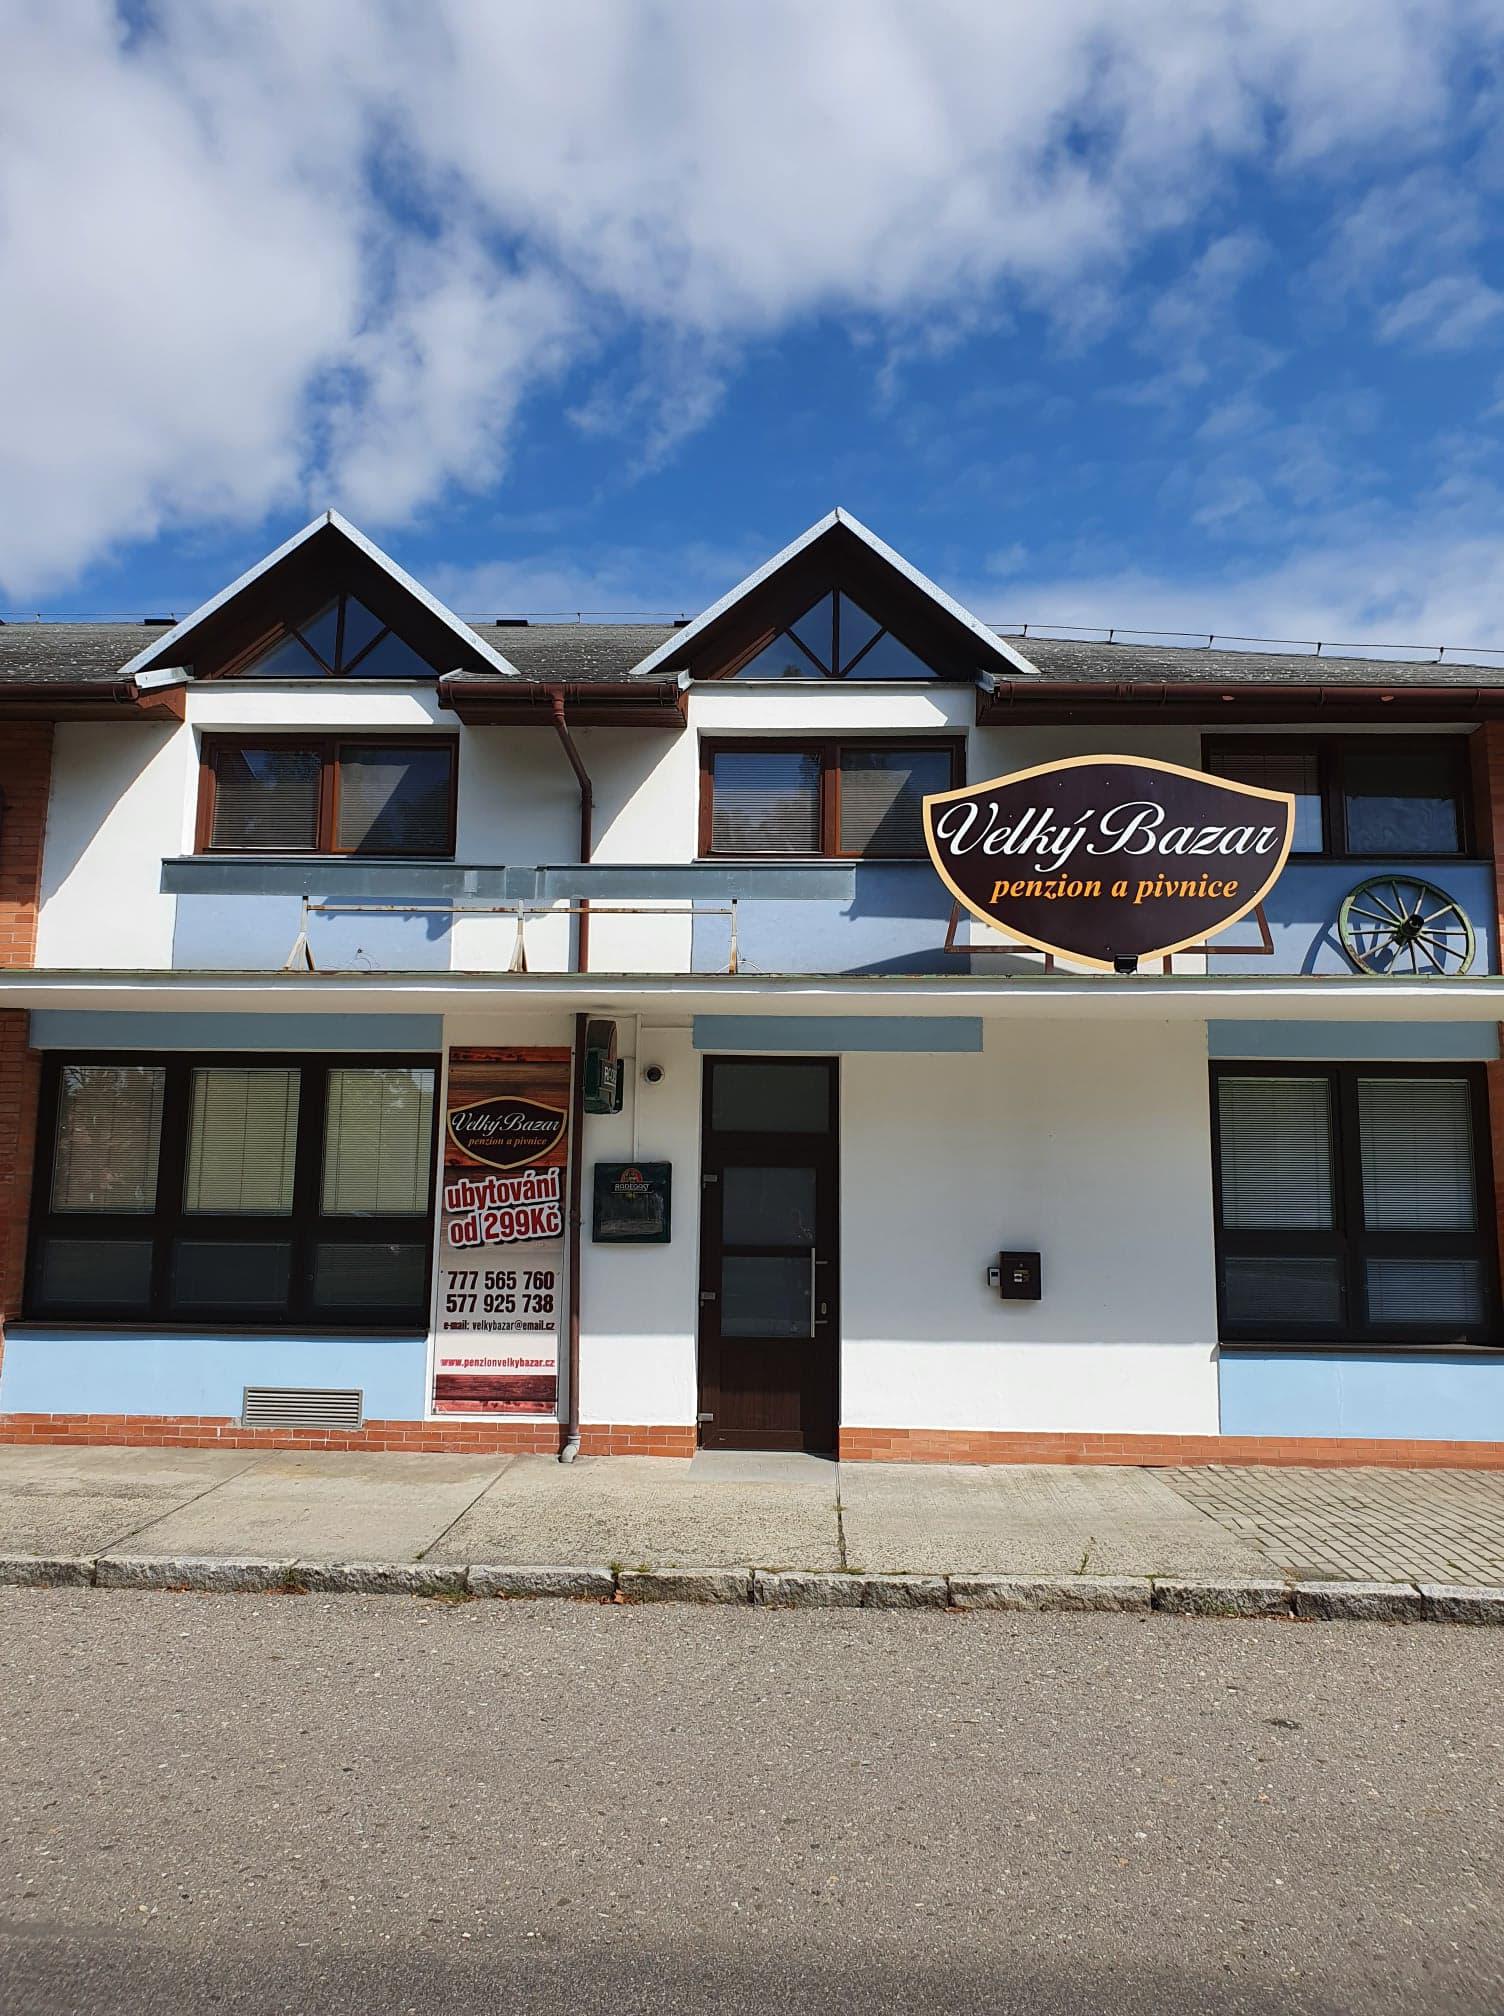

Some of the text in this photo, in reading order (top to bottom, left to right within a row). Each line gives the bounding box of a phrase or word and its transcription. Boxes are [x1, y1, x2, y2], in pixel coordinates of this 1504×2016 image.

[937, 801, 1279, 873] Velký Bazar
[988, 873, 1239, 905] penzion a pivnice
[452, 1112, 560, 1137] Velký Bazar
[467, 1137, 504, 1147] penzion
[513, 1137, 548, 1148] pivnice
[446, 1168, 560, 1210] ubytování
[450, 1206, 560, 1243] od 299Kč
[447, 1271, 555, 1290] 777 565 760
[446, 1294, 554, 1313] 577 925 738
[443, 1320, 555, 1332] e-mail: velkybazar@email.cz
[440, 1357, 556, 1368] www.penzionvelkybazar.cz
